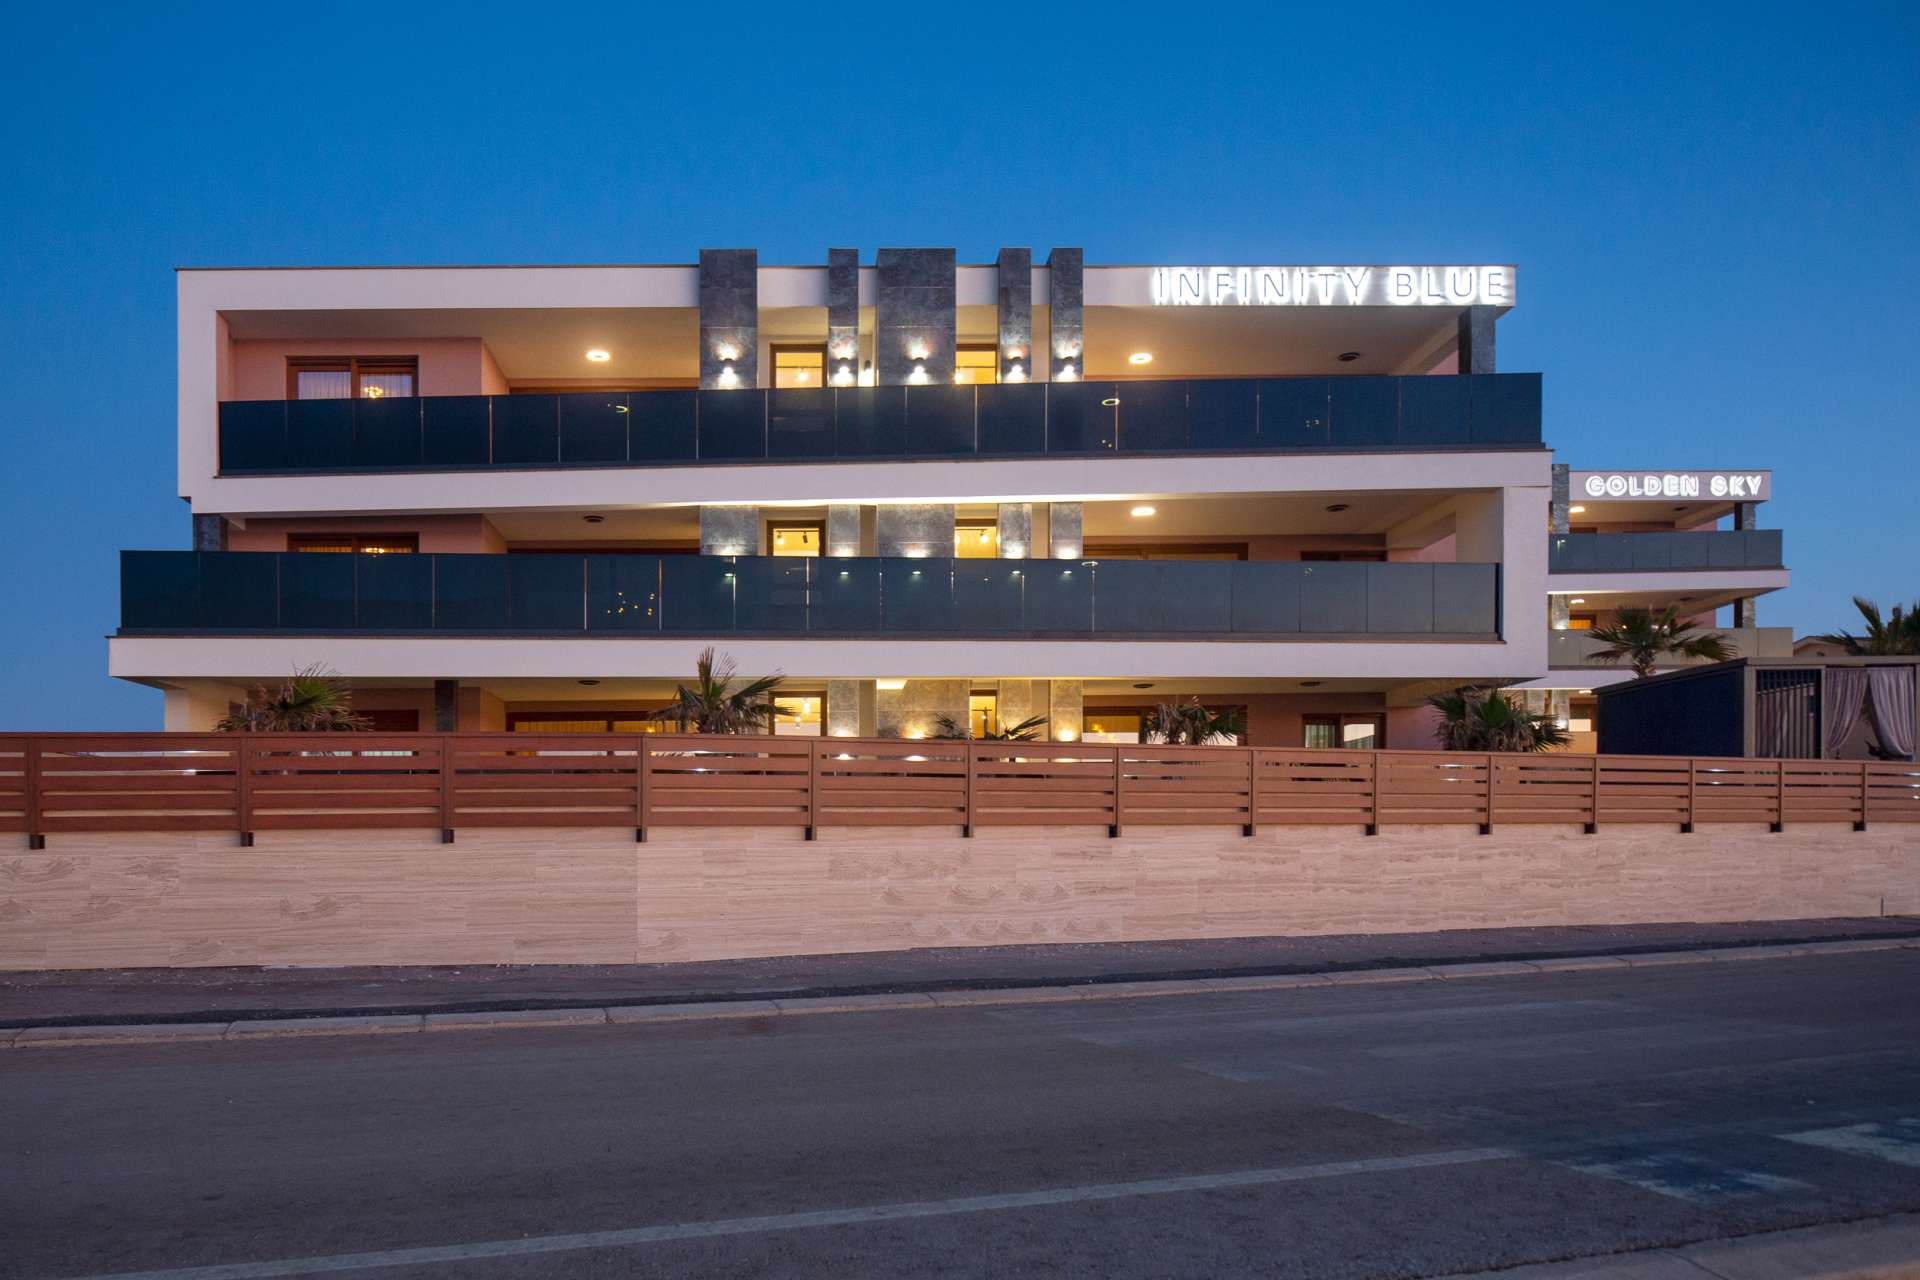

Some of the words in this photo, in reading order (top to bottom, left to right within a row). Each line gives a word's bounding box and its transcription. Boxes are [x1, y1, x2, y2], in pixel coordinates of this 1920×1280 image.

[1155, 267, 1369, 303] INFINITY
[1391, 267, 1507, 303] BLUE
[1586, 475, 1699, 496] GOLDEN
[1710, 475, 1761, 496] SKY
